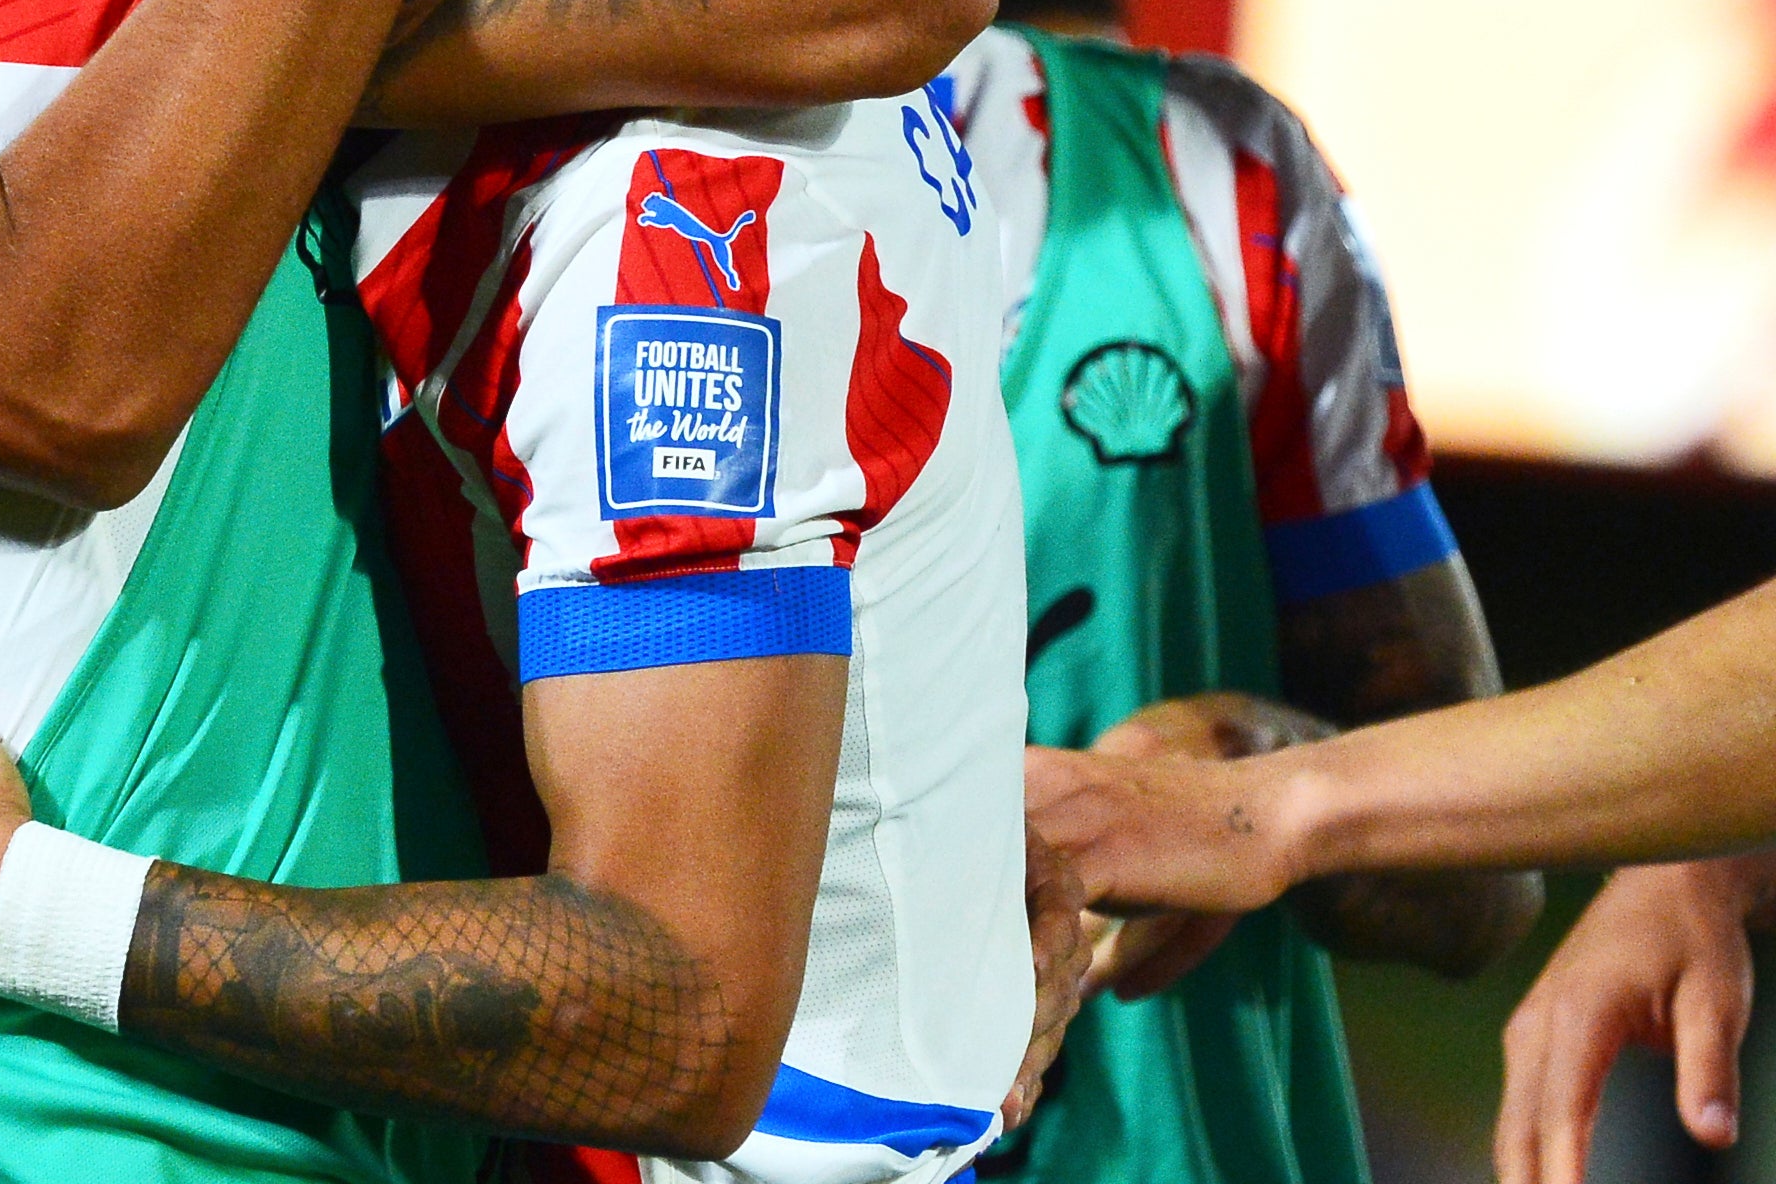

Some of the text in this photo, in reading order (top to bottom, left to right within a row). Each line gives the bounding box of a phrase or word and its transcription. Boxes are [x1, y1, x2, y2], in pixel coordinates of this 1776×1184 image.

[636, 341, 744, 372] FOOTBALL
[634, 370, 743, 412] UNITES
[626, 408, 749, 449] the World
[662, 455, 706, 471] FIFA
